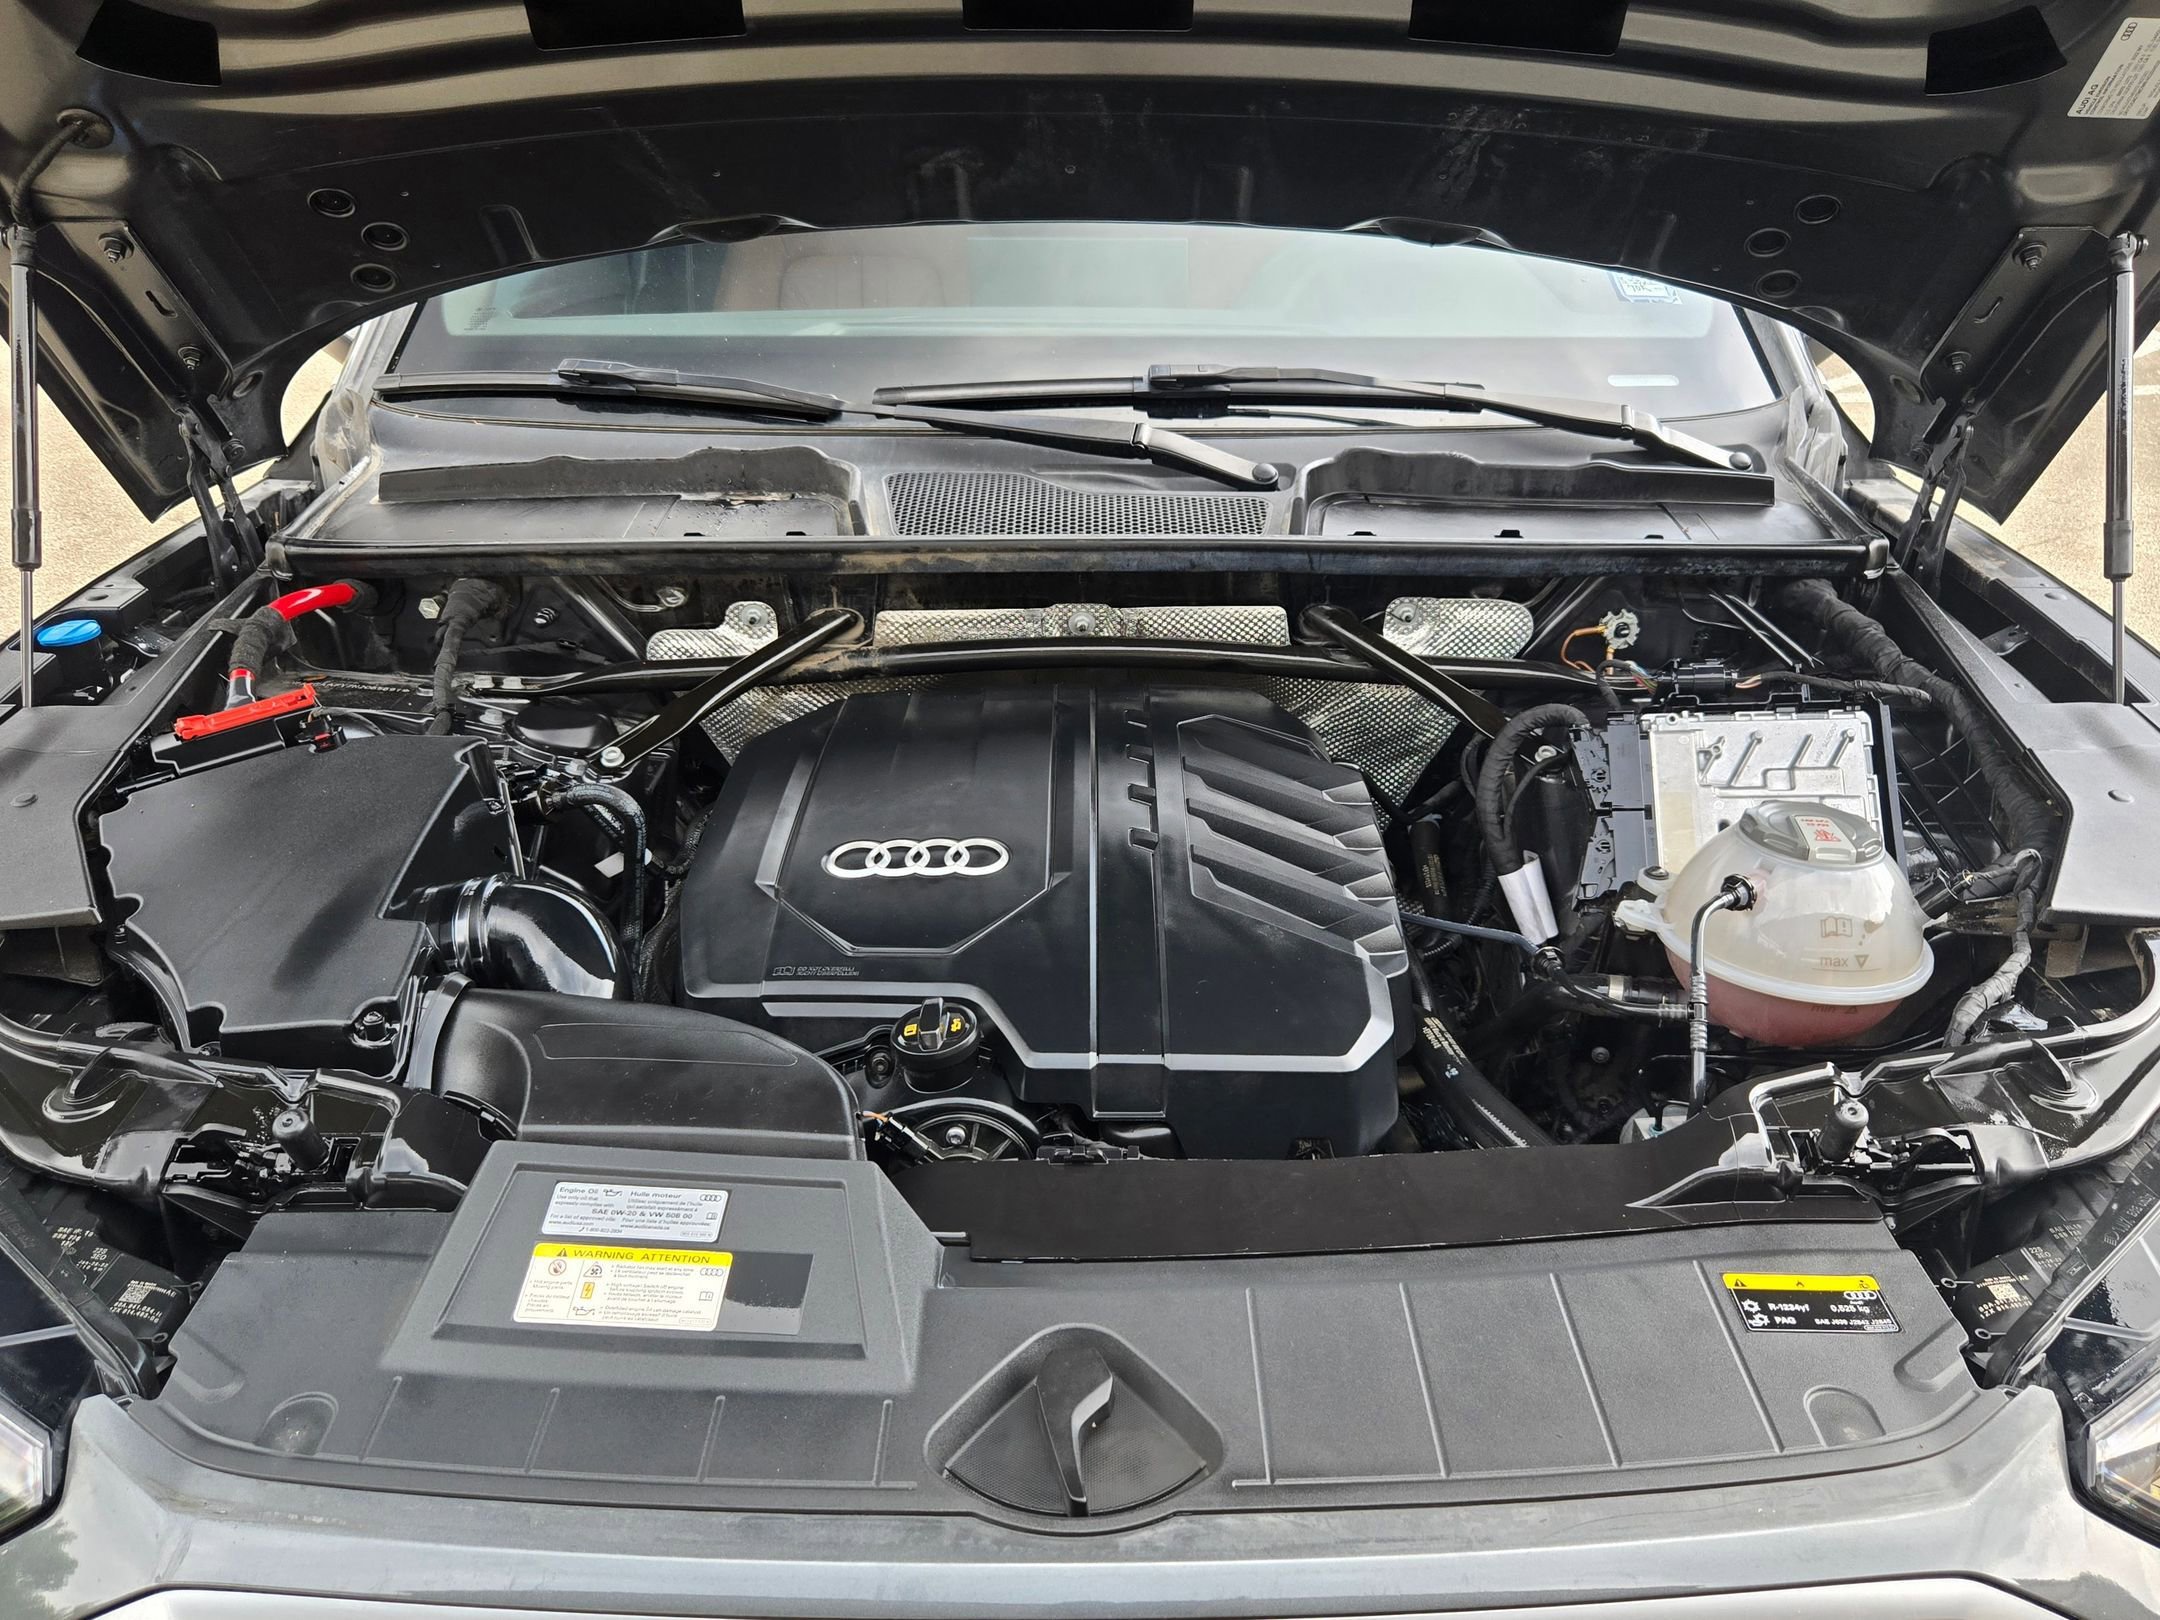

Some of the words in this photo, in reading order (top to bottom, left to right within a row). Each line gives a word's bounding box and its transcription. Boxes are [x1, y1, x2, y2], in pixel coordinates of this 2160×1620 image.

[2076, 97, 2090, 114] AUDI
[2088, 84, 2098, 95] AG
[1820, 957, 1848, 967] max
[560, 1187, 586, 1195] Engine
[610, 1209, 637, 1217] 0W-20
[573, 1249, 634, 1260] WARNING
[641, 1253, 711, 1264] ATTENTION
[1768, 1302, 1810, 1313] R-1234yf
[1857, 1305, 1870, 1314] kg
[1773, 1315, 1797, 1325] PAG
